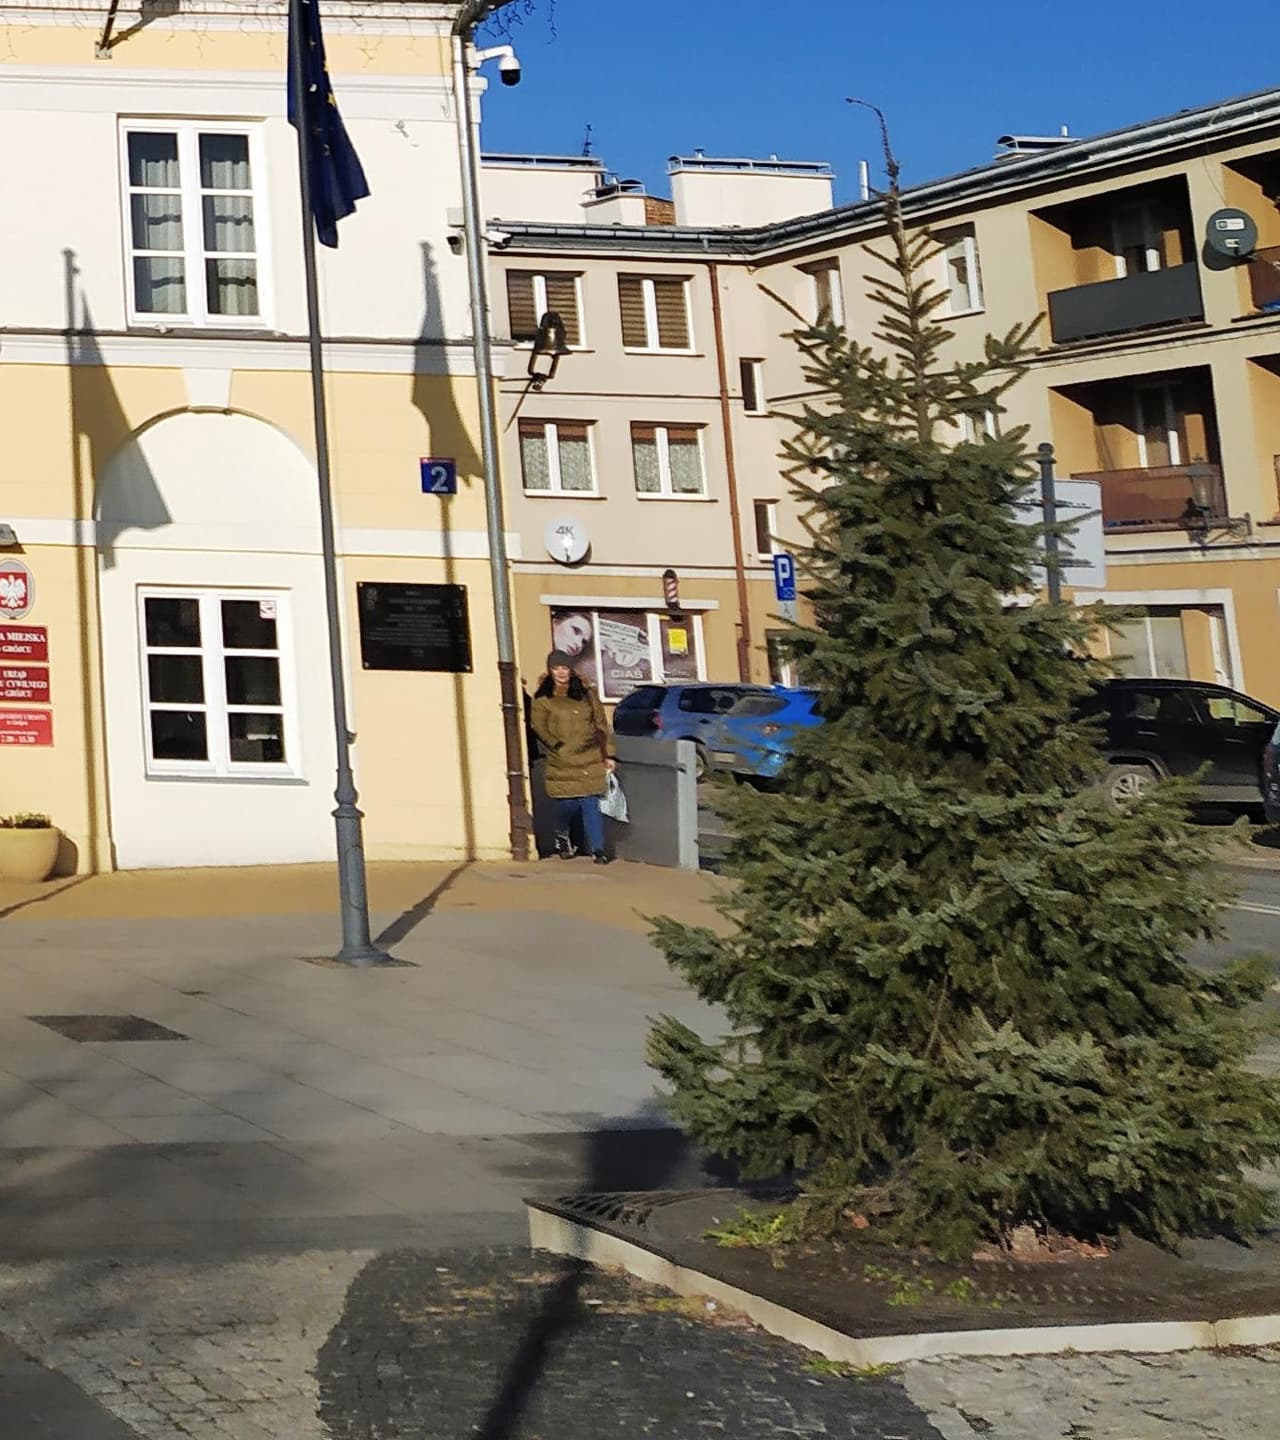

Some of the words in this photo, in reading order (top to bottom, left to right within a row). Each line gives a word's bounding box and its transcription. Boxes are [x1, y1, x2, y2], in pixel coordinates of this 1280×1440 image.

[431, 466, 448, 492] 2
[556, 525, 574, 536] 4K
[778, 558, 791, 587] P
[6, 632, 46, 642] MIEJSKA
